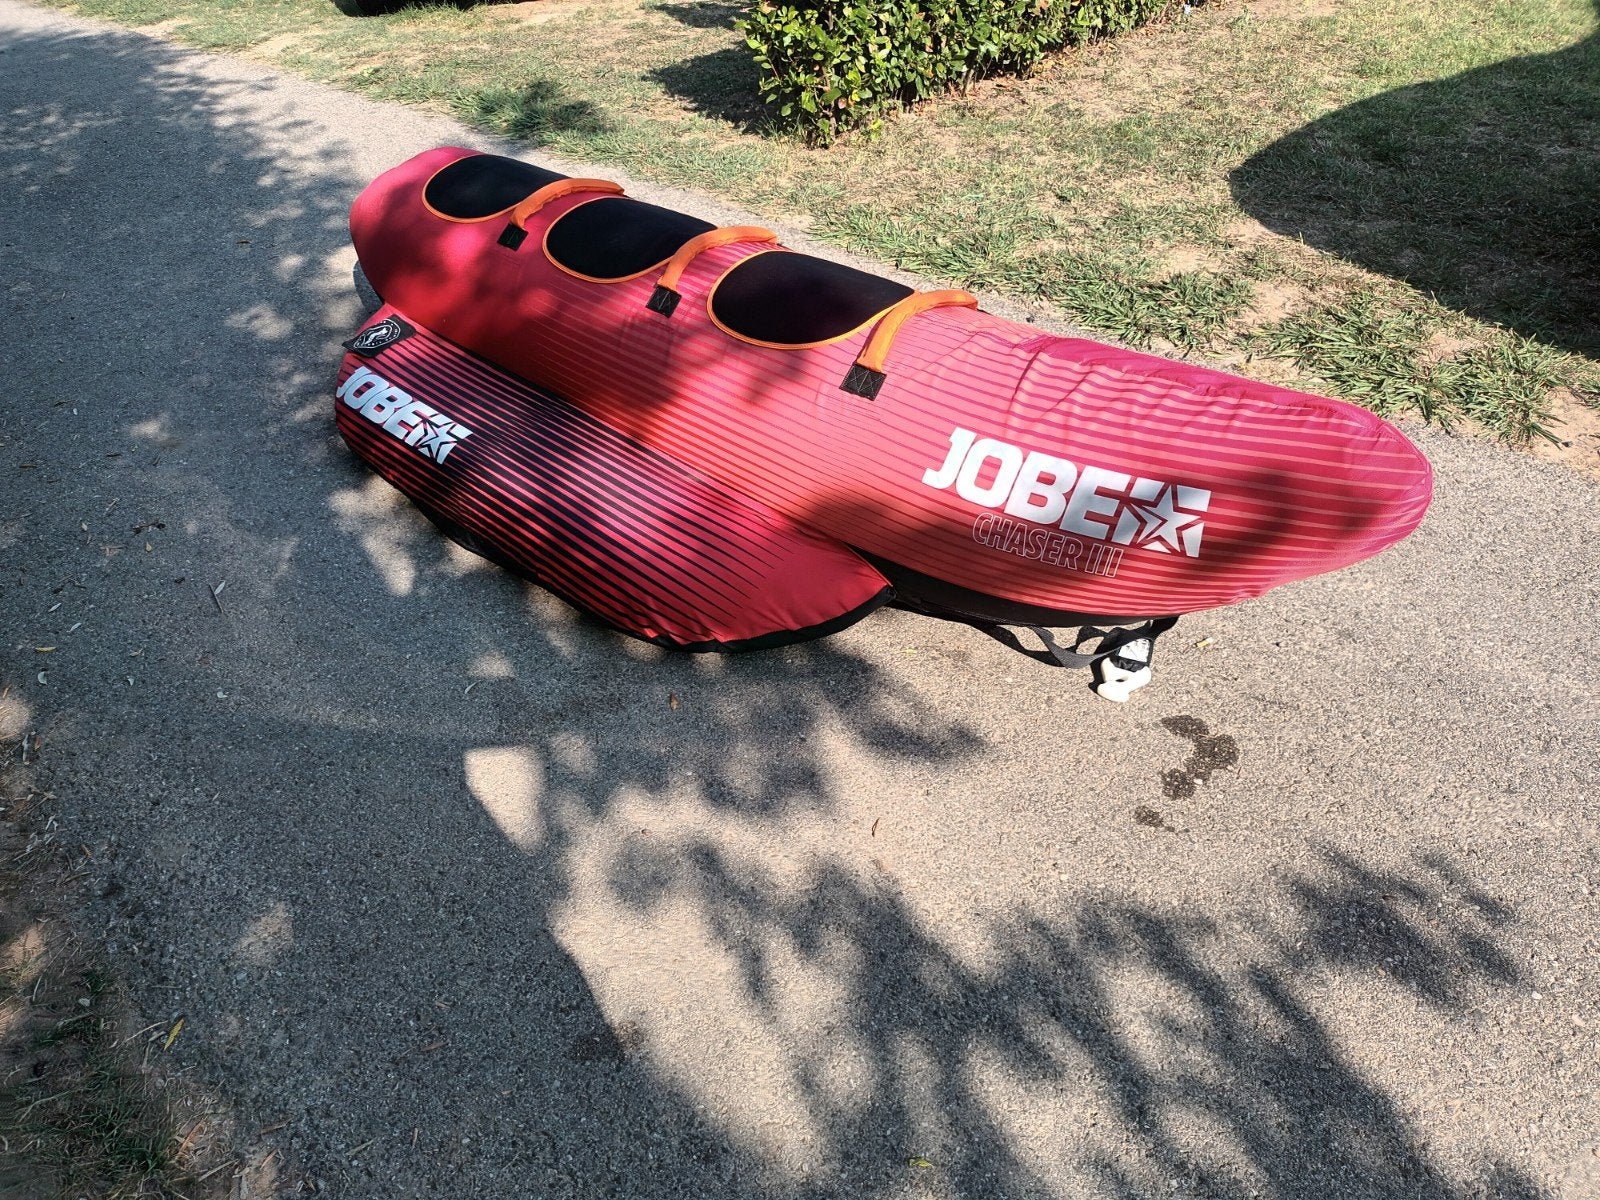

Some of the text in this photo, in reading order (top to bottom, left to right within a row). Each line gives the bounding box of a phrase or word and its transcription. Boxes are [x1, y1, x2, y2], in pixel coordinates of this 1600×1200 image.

[336, 366, 440, 440] JOBE
[922, 427, 1132, 540] JOBE
[972, 512, 1124, 578] CHASER III
